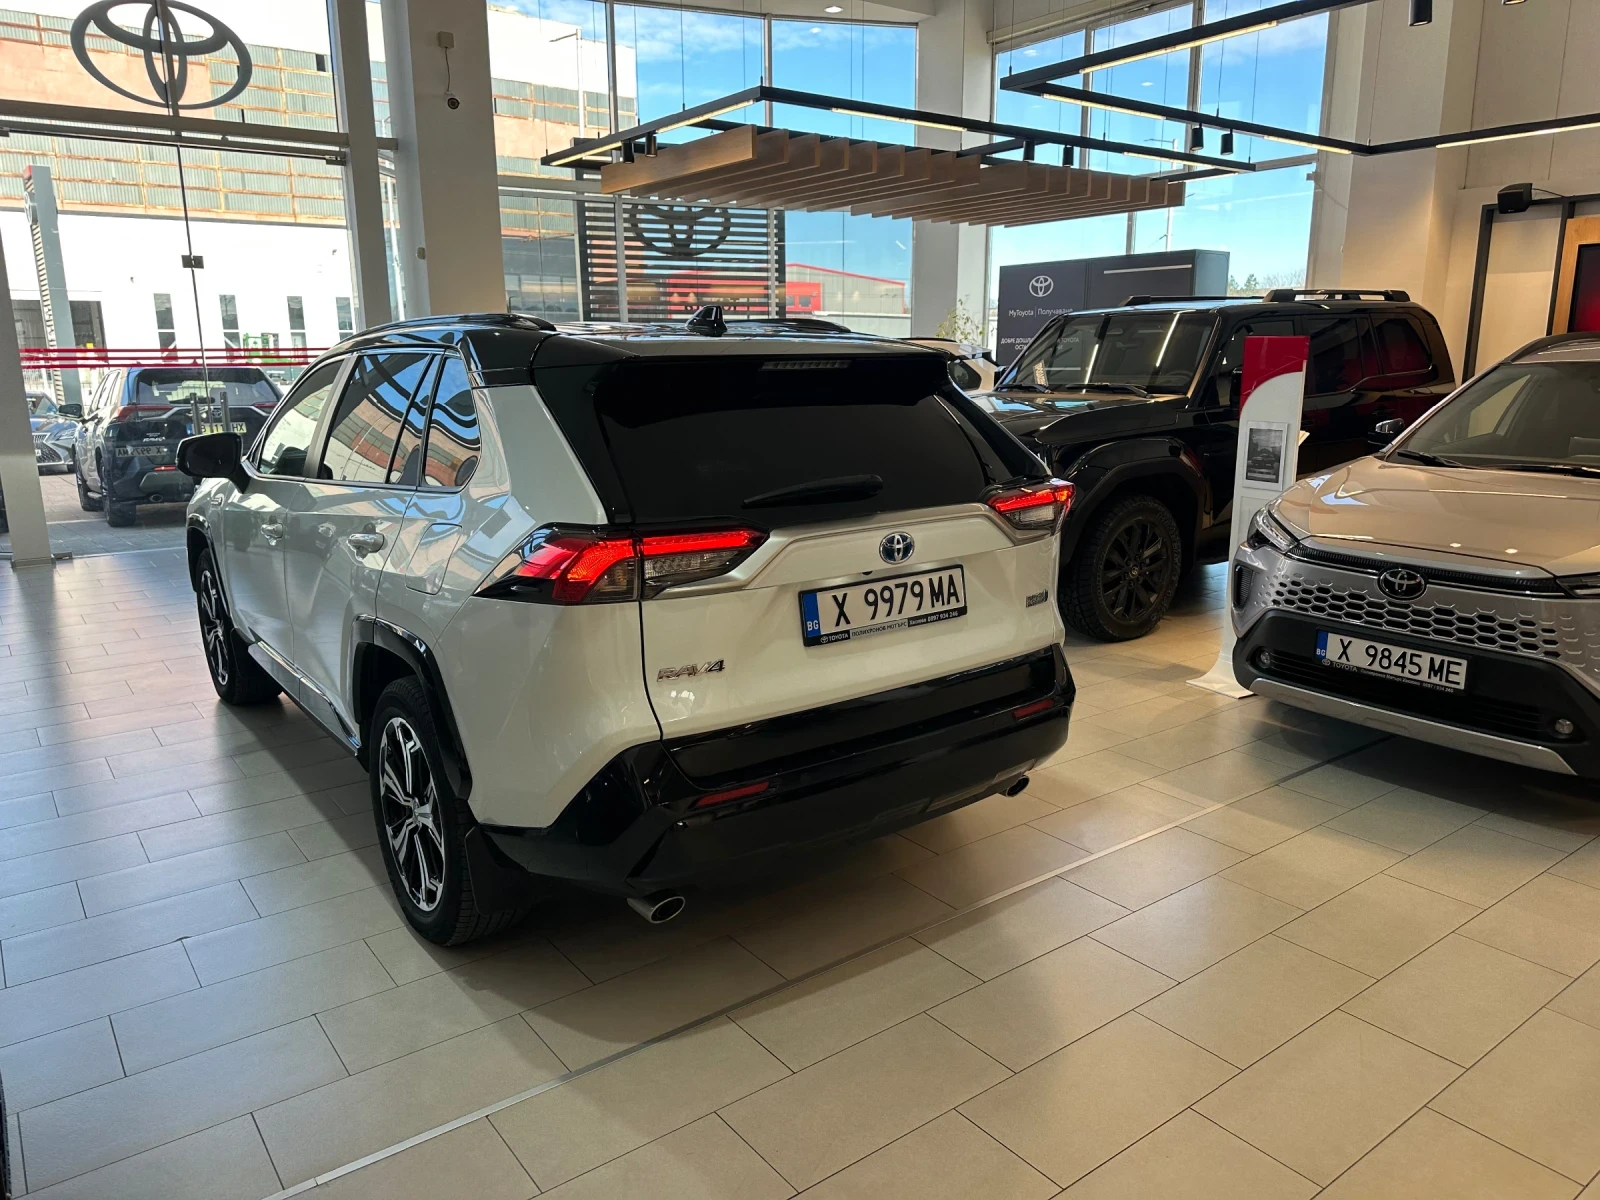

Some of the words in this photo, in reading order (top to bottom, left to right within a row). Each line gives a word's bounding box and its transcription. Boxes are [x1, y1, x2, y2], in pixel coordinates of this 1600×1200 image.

[1009, 309, 1034, 318] MyToyota
[832, 593, 851, 627] X
[864, 581, 924, 620] 9979
[929, 574, 960, 608] MA
[807, 620, 819, 631] BG
[887, 621, 907, 631] МОТЪРС
[829, 633, 849, 642] TOYOTA
[1316, 648, 1326, 656] BG
[1332, 662, 1358, 672] TOYOTA
[1337, 638, 1352, 662] X
[1365, 645, 1422, 676] 9845
[1427, 657, 1462, 686] ME
[656, 658, 725, 682] RAV4
